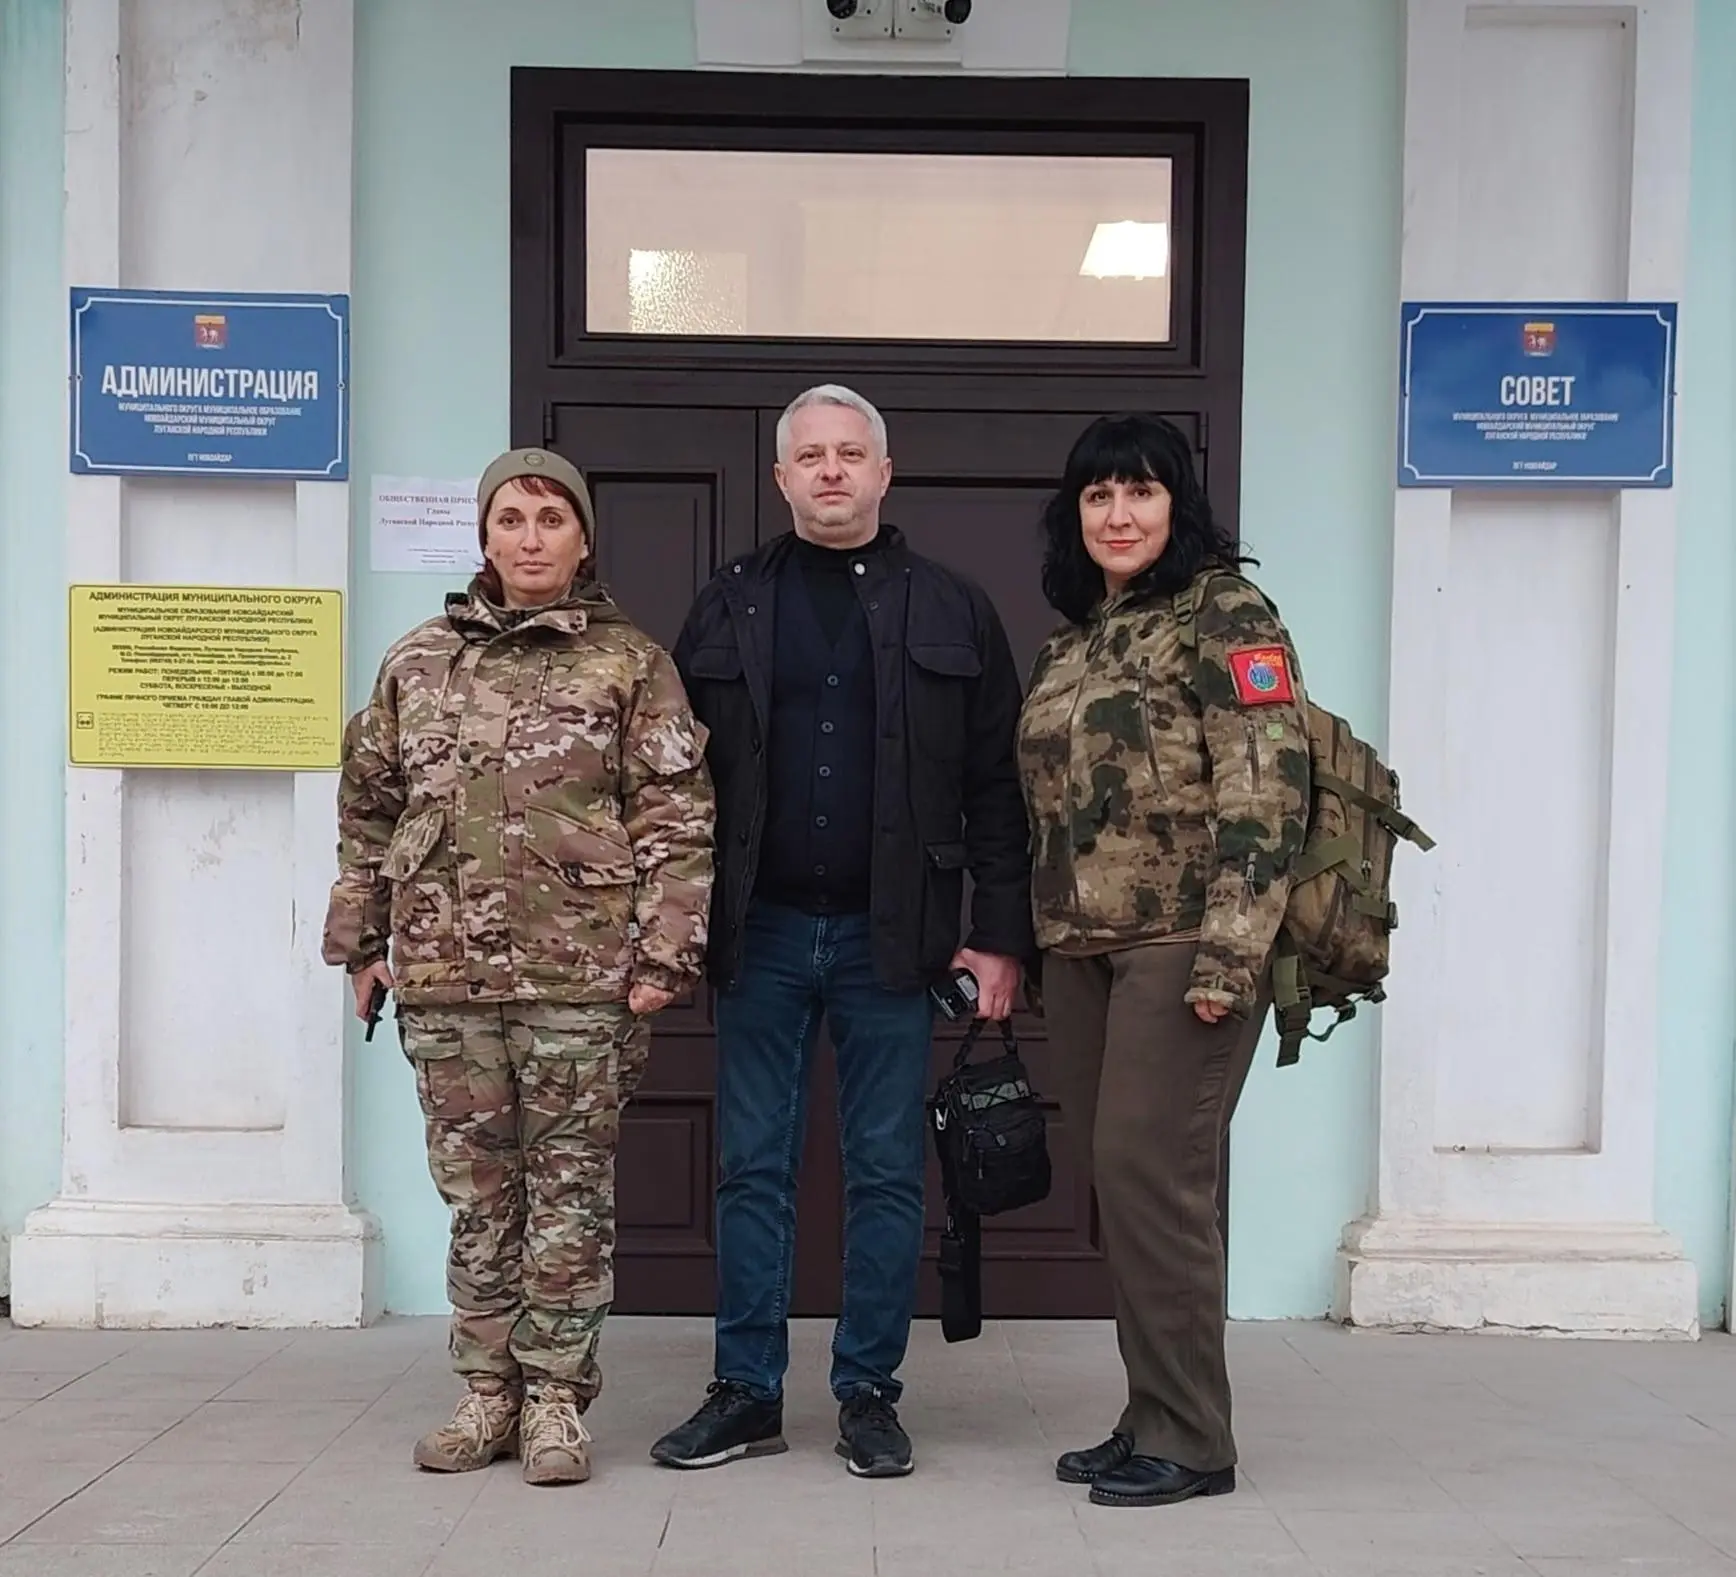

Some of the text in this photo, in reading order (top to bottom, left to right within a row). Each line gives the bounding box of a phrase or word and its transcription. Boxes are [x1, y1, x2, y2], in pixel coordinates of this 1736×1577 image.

[101, 365, 318, 402] АДМИНИСТРАЦИЯ
[1501, 376, 1576, 406] СОВЕТ
[379, 495, 449, 504] ОБЩЕСТВЕННАЯ
[379, 517, 478, 528] Луганской Народной Респу
[89, 591, 322, 605] АДМИНИСТРАЦИЯ МУНИЦИПАЛЬНОГО ОКРУГА
[224, 628, 291, 636] МУНИЦИПАЛЬНОГО
[139, 682, 174, 690] СУББОТА,
